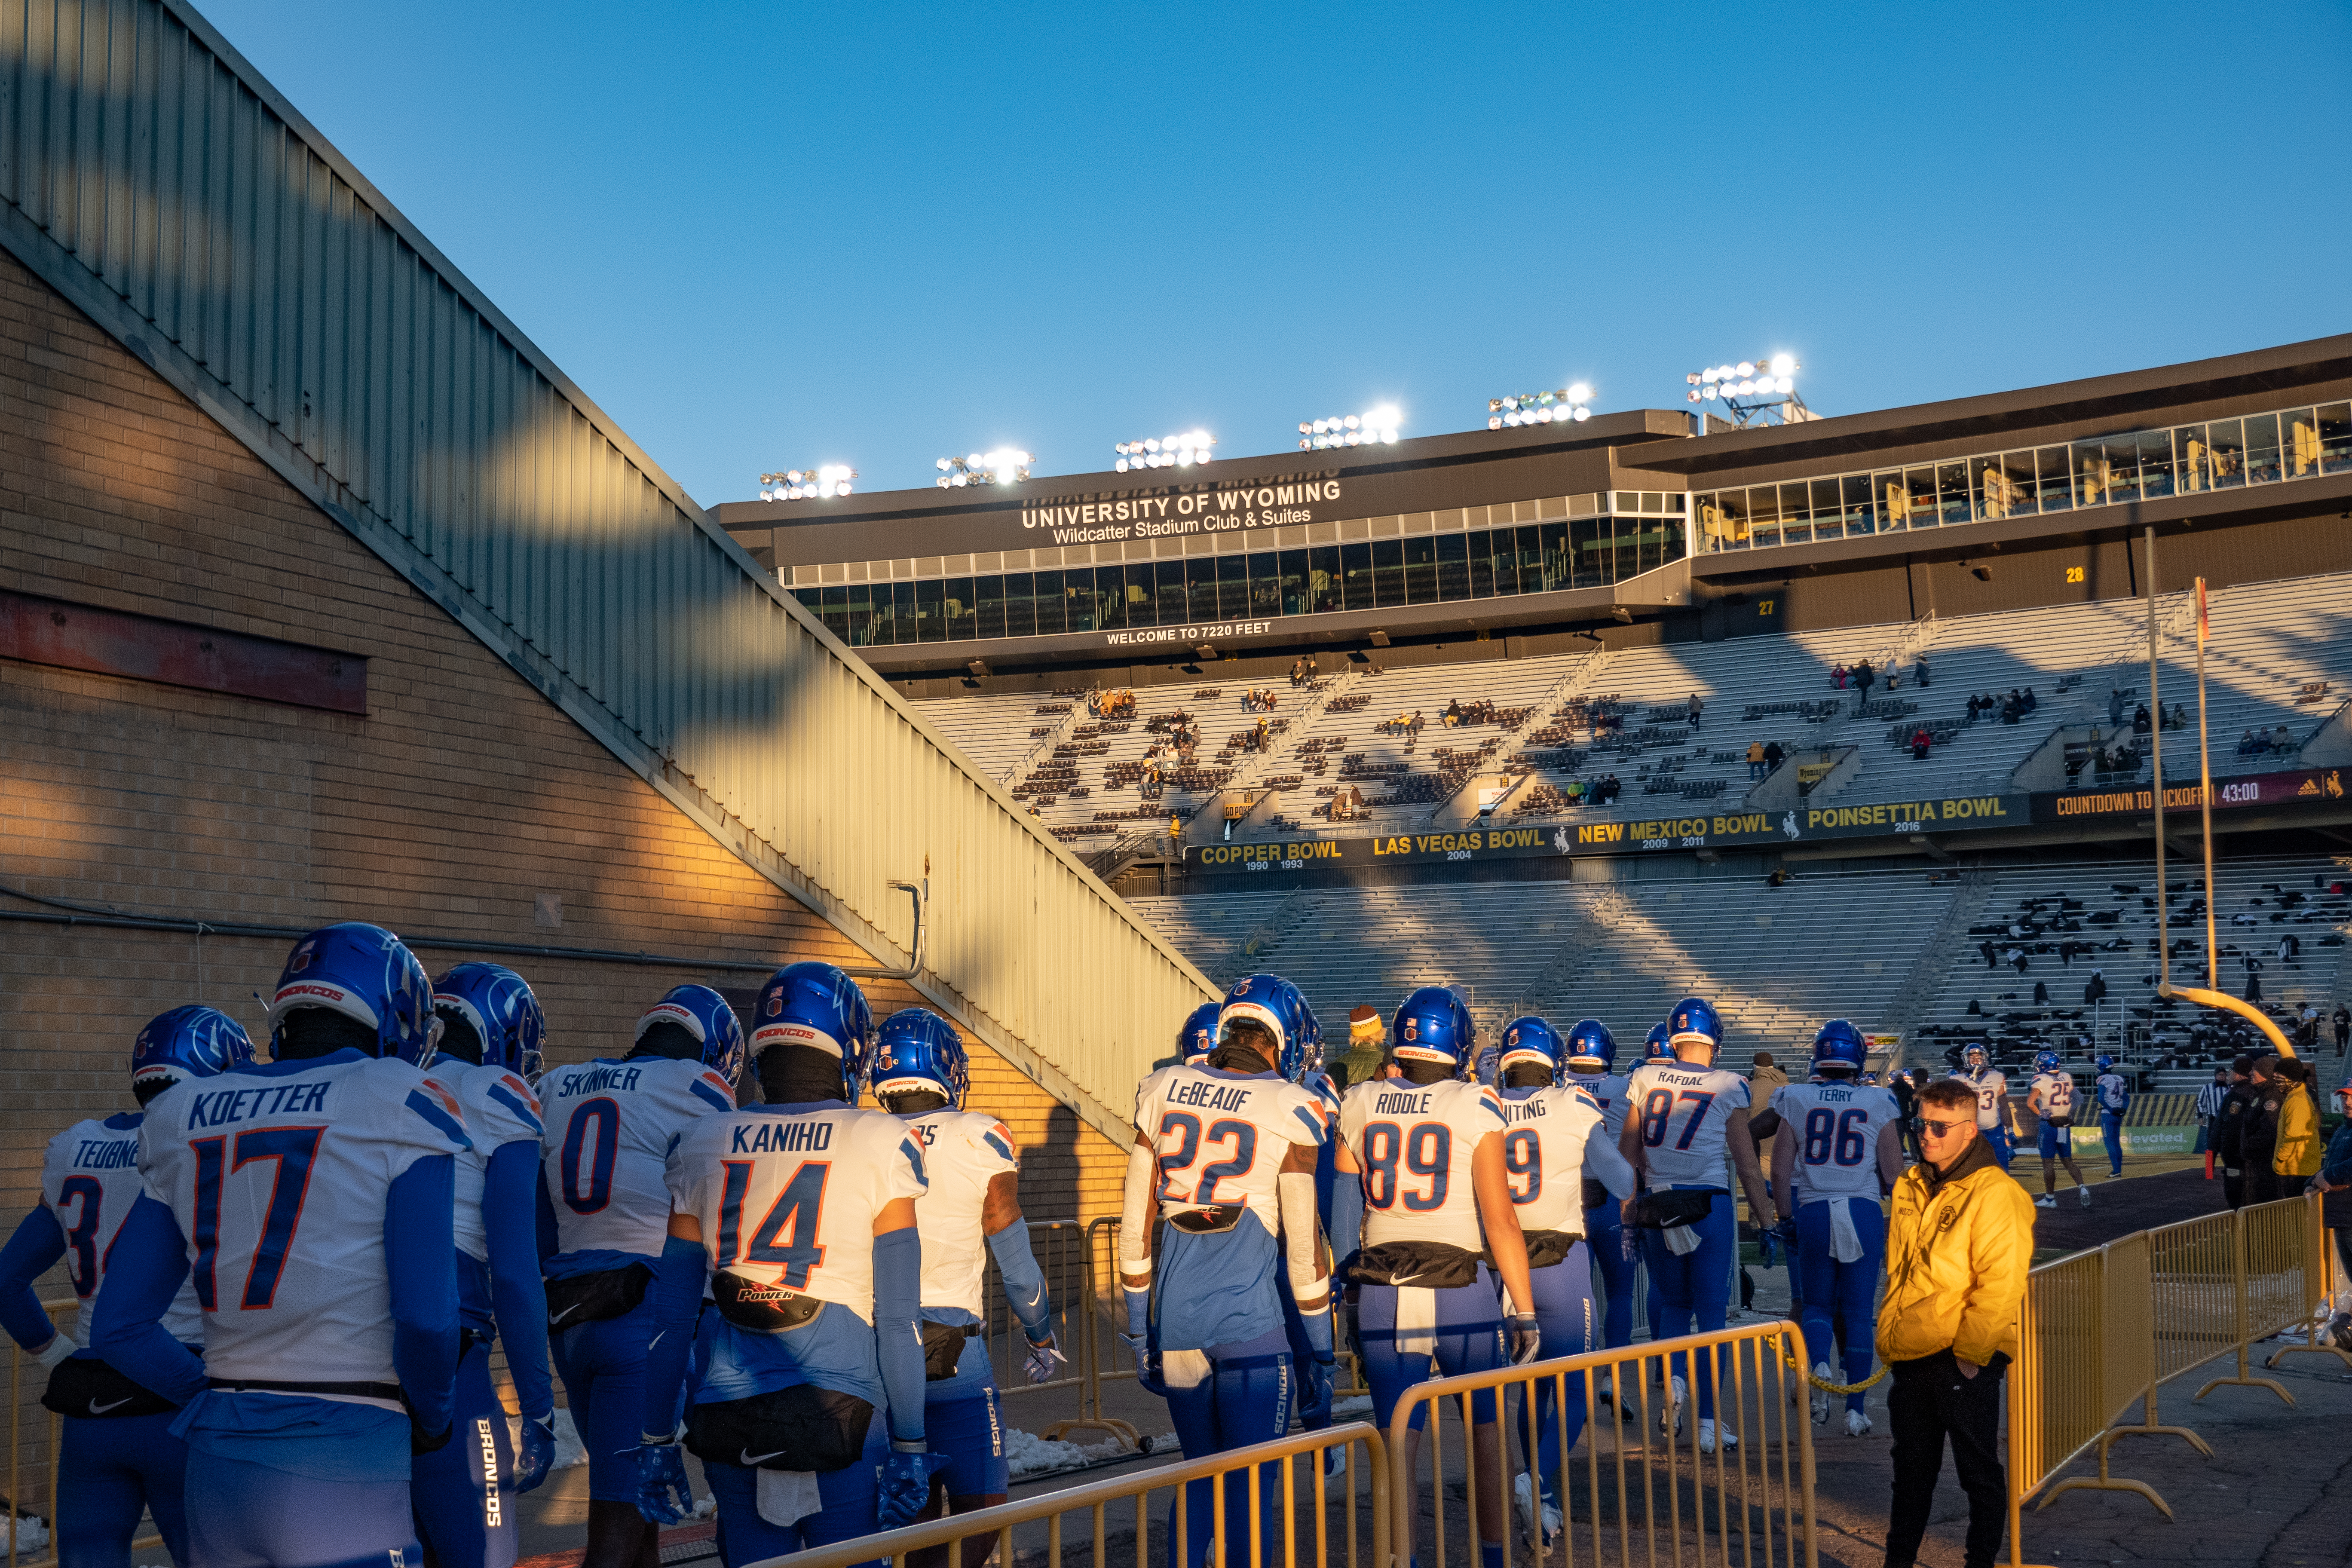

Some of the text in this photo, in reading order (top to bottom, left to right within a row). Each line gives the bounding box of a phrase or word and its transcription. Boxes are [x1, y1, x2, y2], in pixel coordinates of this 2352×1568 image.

[1022, 481, 1341, 529] UNIVERSITY OF WYOMING
[1052, 508, 1311, 544] Wildcatter Stadium Club & Suites
[2066, 567, 2084, 583] 28
[1759, 600, 1774, 616] 27
[1107, 622, 1271, 645] WELCOME TO 7220 FEET
[2057, 793, 2134, 815] COUNTDOWN
[2136, 791, 2152, 809] TO
[2223, 782, 2259, 802] 43:00
[1225, 806, 1234, 816] GO
[1808, 797, 2006, 828] POINSETTIA BOWL
[1578, 814, 1773, 843] NEW MEXICO BOWL
[1895, 821, 1920, 832] 2016
[1201, 841, 1341, 864] COPPER BOWL
[1374, 829, 1545, 856] LAS VEGAS BOWL
[1447, 850, 1471, 861] 2004
[1643, 836, 1704, 849] 2009 2011
[1246, 859, 1303, 871] 1990 1993
[274, 985, 345, 1004] BRONCOS
[756, 1027, 815, 1041] BRONCOS
[1397, 1050, 1438, 1059] BRONCOS
[1504, 1052, 1537, 1062] BRONCOS
[559, 1067, 641, 1098] SKINNER
[886, 1080, 919, 1088] BRONCOS
[1166, 1079, 1252, 1112] LeBEAUF
[1819, 1089, 1853, 1102] TERRY
[2049, 1081, 2071, 1107] 25
[188, 1081, 332, 1130] KOETTER
[1375, 1093, 1432, 1115] RIDDLE
[1643, 1087, 1716, 1150] 87
[731, 1122, 833, 1153] KANIHO
[1805, 1108, 1868, 1167] 86
[2119, 1132, 2187, 1143] elevated.
[74, 1140, 139, 1169] TEUBNE
[560, 1097, 620, 1216] 0
[1156, 1110, 1258, 1208] 22
[1363, 1121, 1452, 1212] 89
[188, 1125, 329, 1312] 17
[717, 1160, 832, 1292] 14
[1274, 1354, 1287, 1434] BRONCOS
[478, 1418, 501, 1527] BRONCOS
